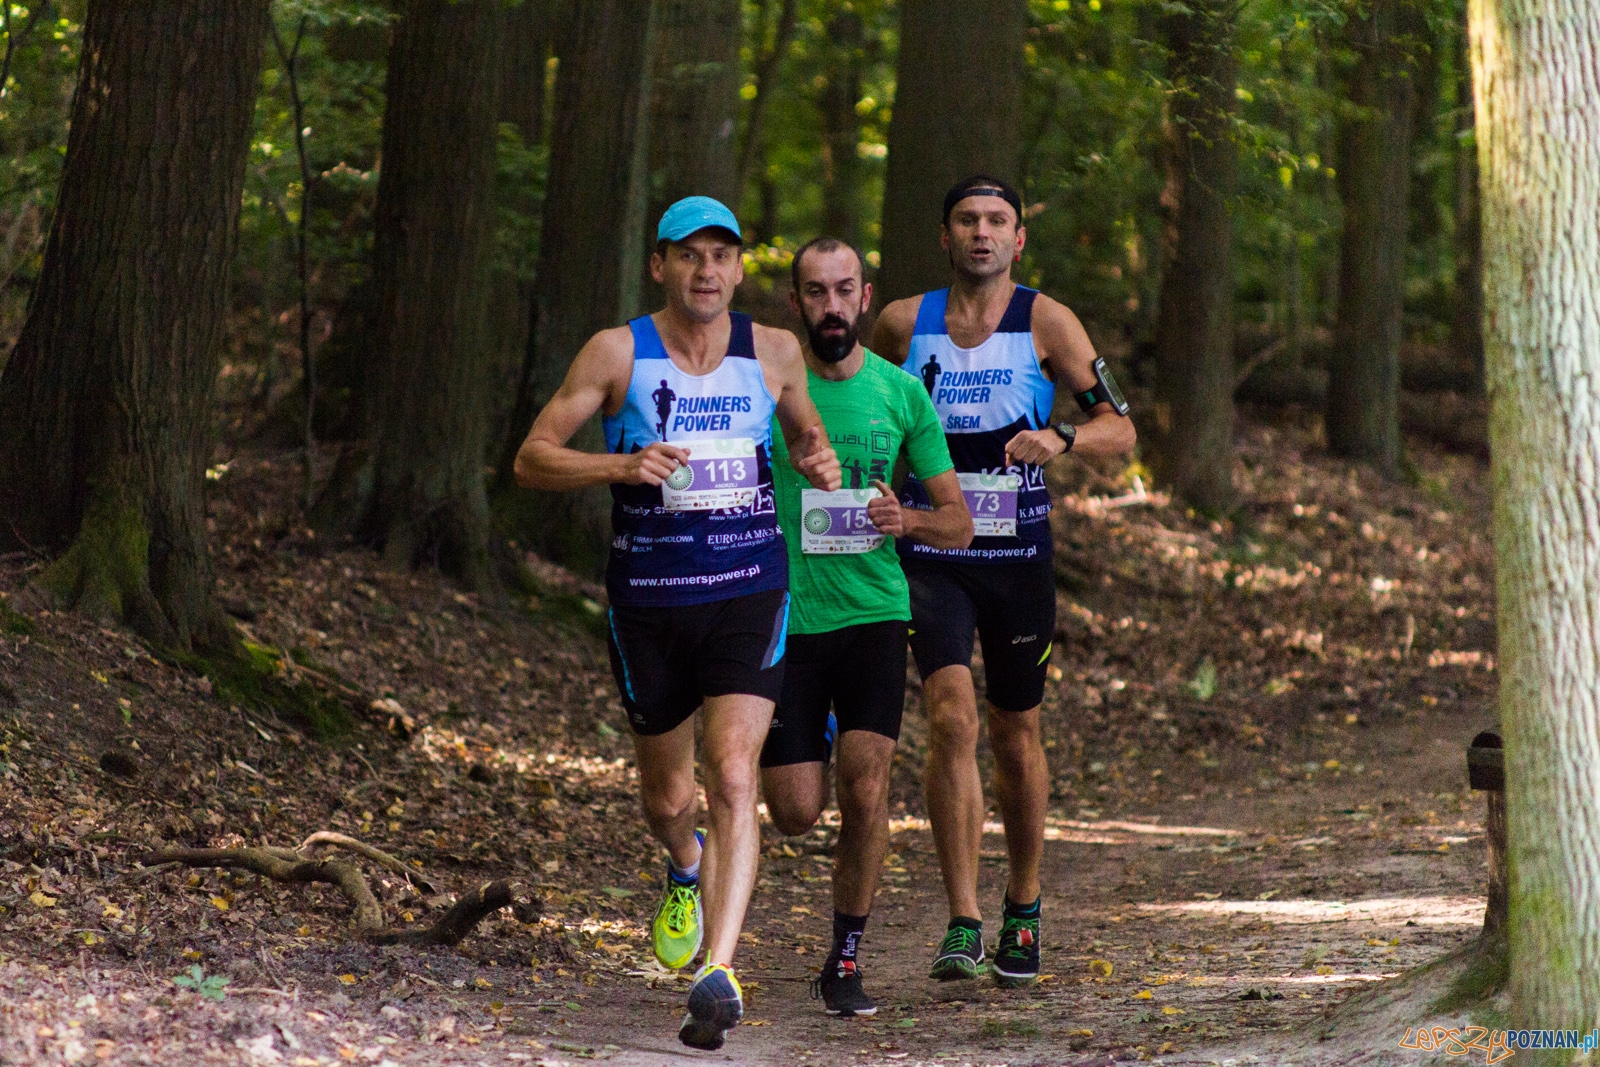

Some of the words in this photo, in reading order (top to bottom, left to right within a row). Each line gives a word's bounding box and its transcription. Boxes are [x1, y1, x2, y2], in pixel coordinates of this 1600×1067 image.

[941, 369, 1013, 387] RUNNER'S
[676, 396, 752, 413] RUNNER'S
[937, 387, 991, 404] POWER
[673, 414, 731, 432] POWER
[947, 414, 981, 429] ŚREM
[705, 460, 746, 482] 113
[974, 493, 1000, 512] 73
[842, 509, 876, 529] 15
[913, 544, 1037, 559] www.runnerspower.pl
[629, 564, 761, 586] www.runnerspower.pl
